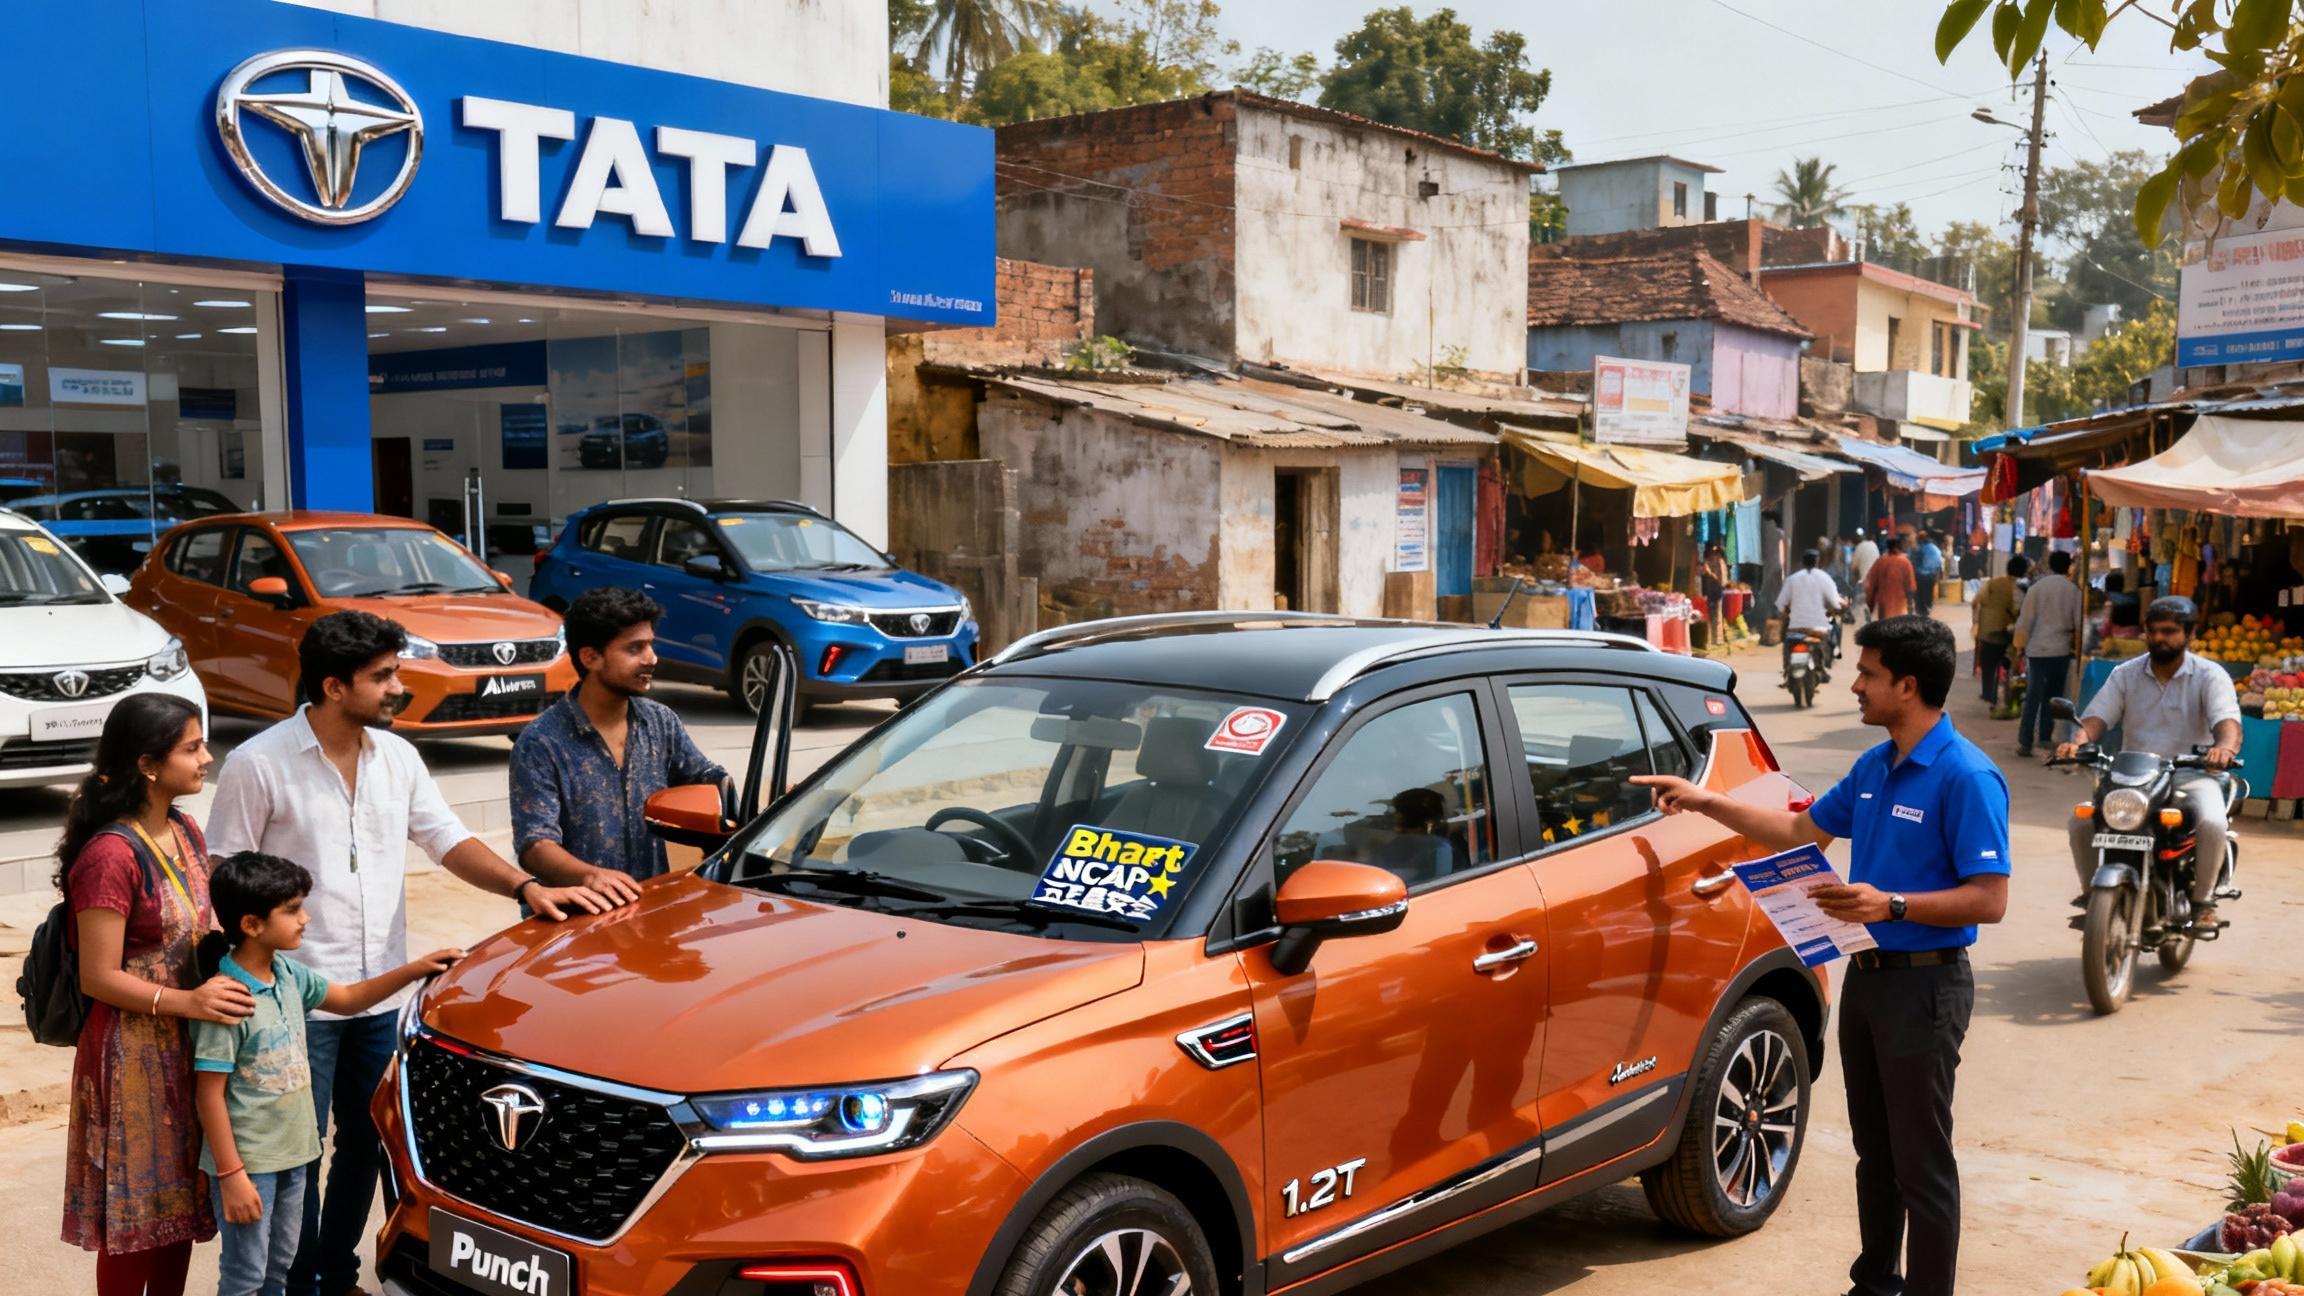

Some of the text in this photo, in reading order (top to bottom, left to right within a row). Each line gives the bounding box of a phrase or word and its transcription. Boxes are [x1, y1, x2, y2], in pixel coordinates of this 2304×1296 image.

[463, 95, 842, 257] TATA
[1052, 858, 1150, 891] NCAP
[1282, 1157, 1366, 1217] 1.2T
[450, 1231, 550, 1296] Punch
